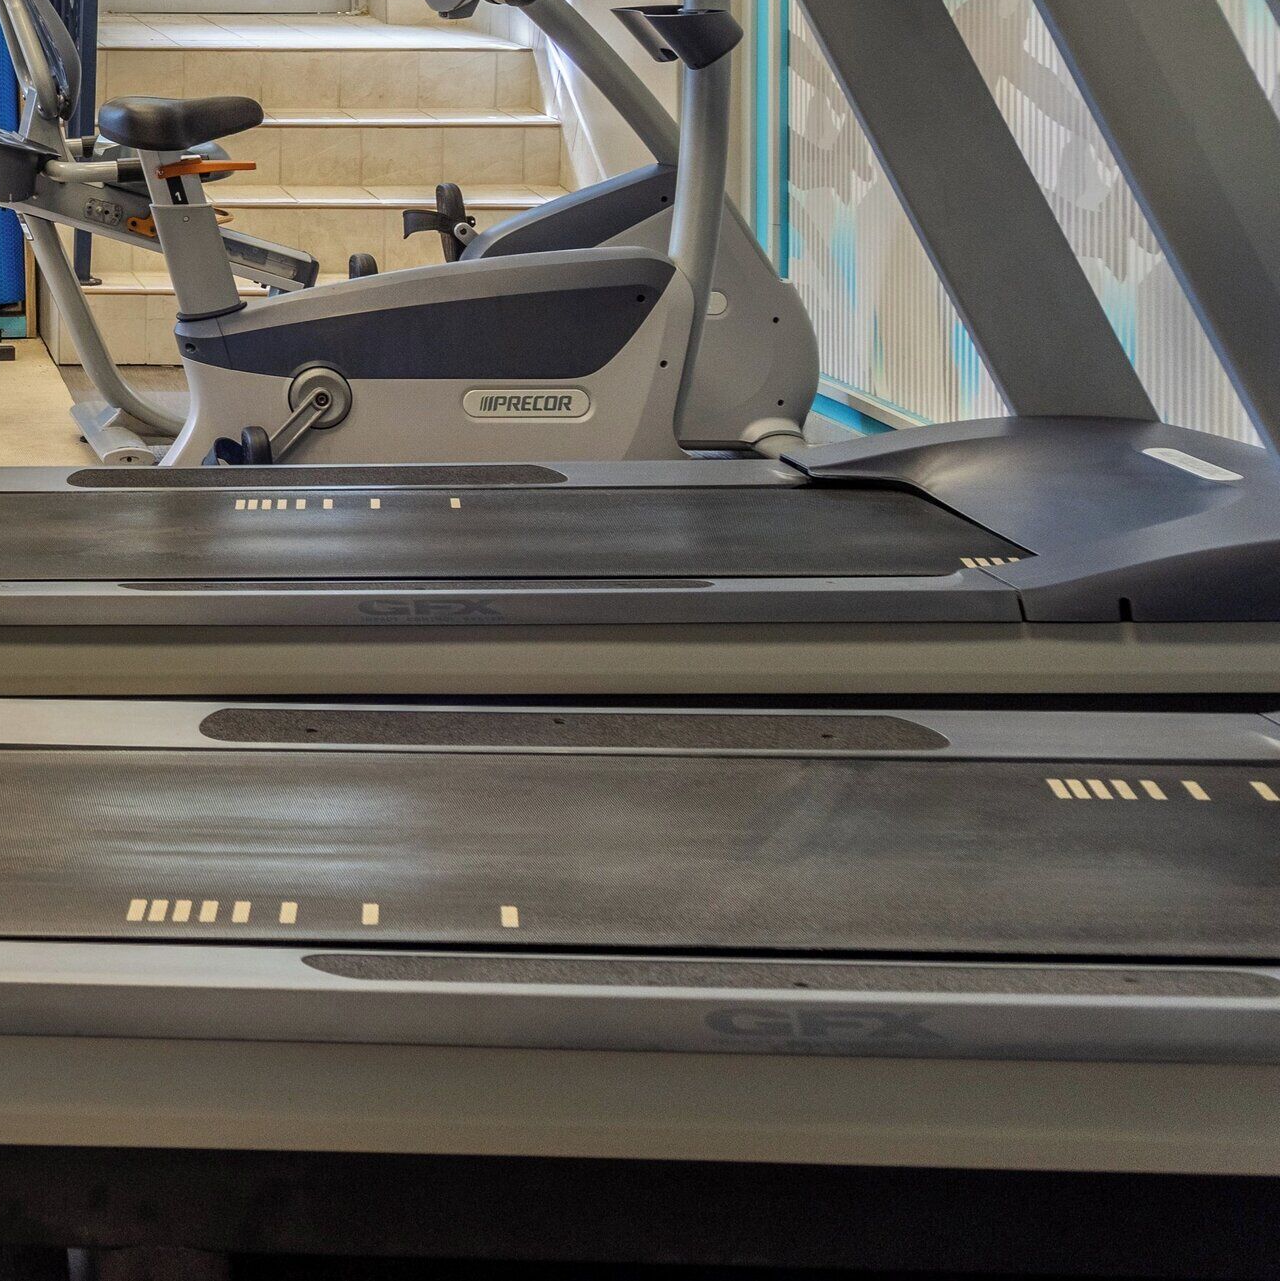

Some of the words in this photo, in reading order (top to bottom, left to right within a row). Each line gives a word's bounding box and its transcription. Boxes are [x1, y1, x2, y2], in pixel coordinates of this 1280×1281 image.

[174, 192, 182, 201] 1
[493, 395, 572, 411] PRECOR
[357, 599, 503, 616] GFX
[705, 1008, 945, 1037] GFX
